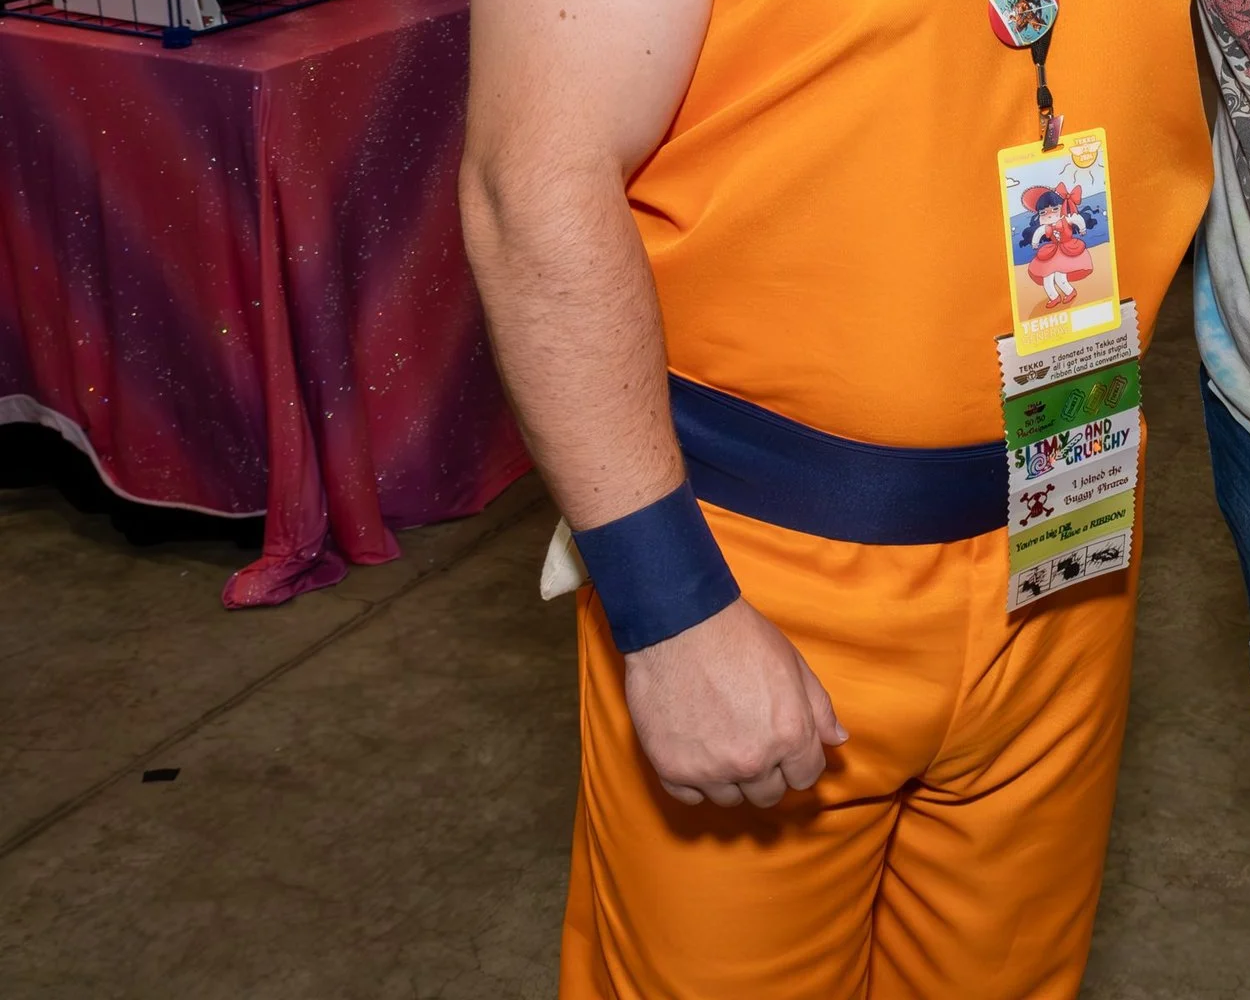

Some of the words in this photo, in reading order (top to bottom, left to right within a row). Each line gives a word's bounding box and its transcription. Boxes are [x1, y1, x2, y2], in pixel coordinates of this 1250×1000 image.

[1021, 312, 1068, 335] TEKKO
[1053, 362, 1061, 372] all
[1066, 359, 1078, 370] got
[1079, 355, 1092, 363] was
[1093, 348, 1107, 359] this
[1107, 342, 1128, 357] stupid
[1057, 347, 1084, 361] donated
[1095, 339, 1115, 350] Tekko
[1116, 333, 1128, 343] and
[1018, 360, 1044, 374] TEKKO
[1050, 367, 1073, 380] ribbon
[1073, 362, 1088, 376] (and
[1094, 348, 1132, 366] convention)
[1085, 418, 1112, 441] AND
[1014, 431, 1070, 470] SLIMY
[1065, 427, 1130, 466] CRUNCHY
[1080, 471, 1106, 489] joined
[1108, 465, 1122, 477] the
[1063, 488, 1094, 506] Buggy
[1097, 476, 1129, 494] Pirates
[1039, 534, 1045, 542] a
[1045, 528, 1058, 540] big
[1060, 528, 1081, 542] Have
